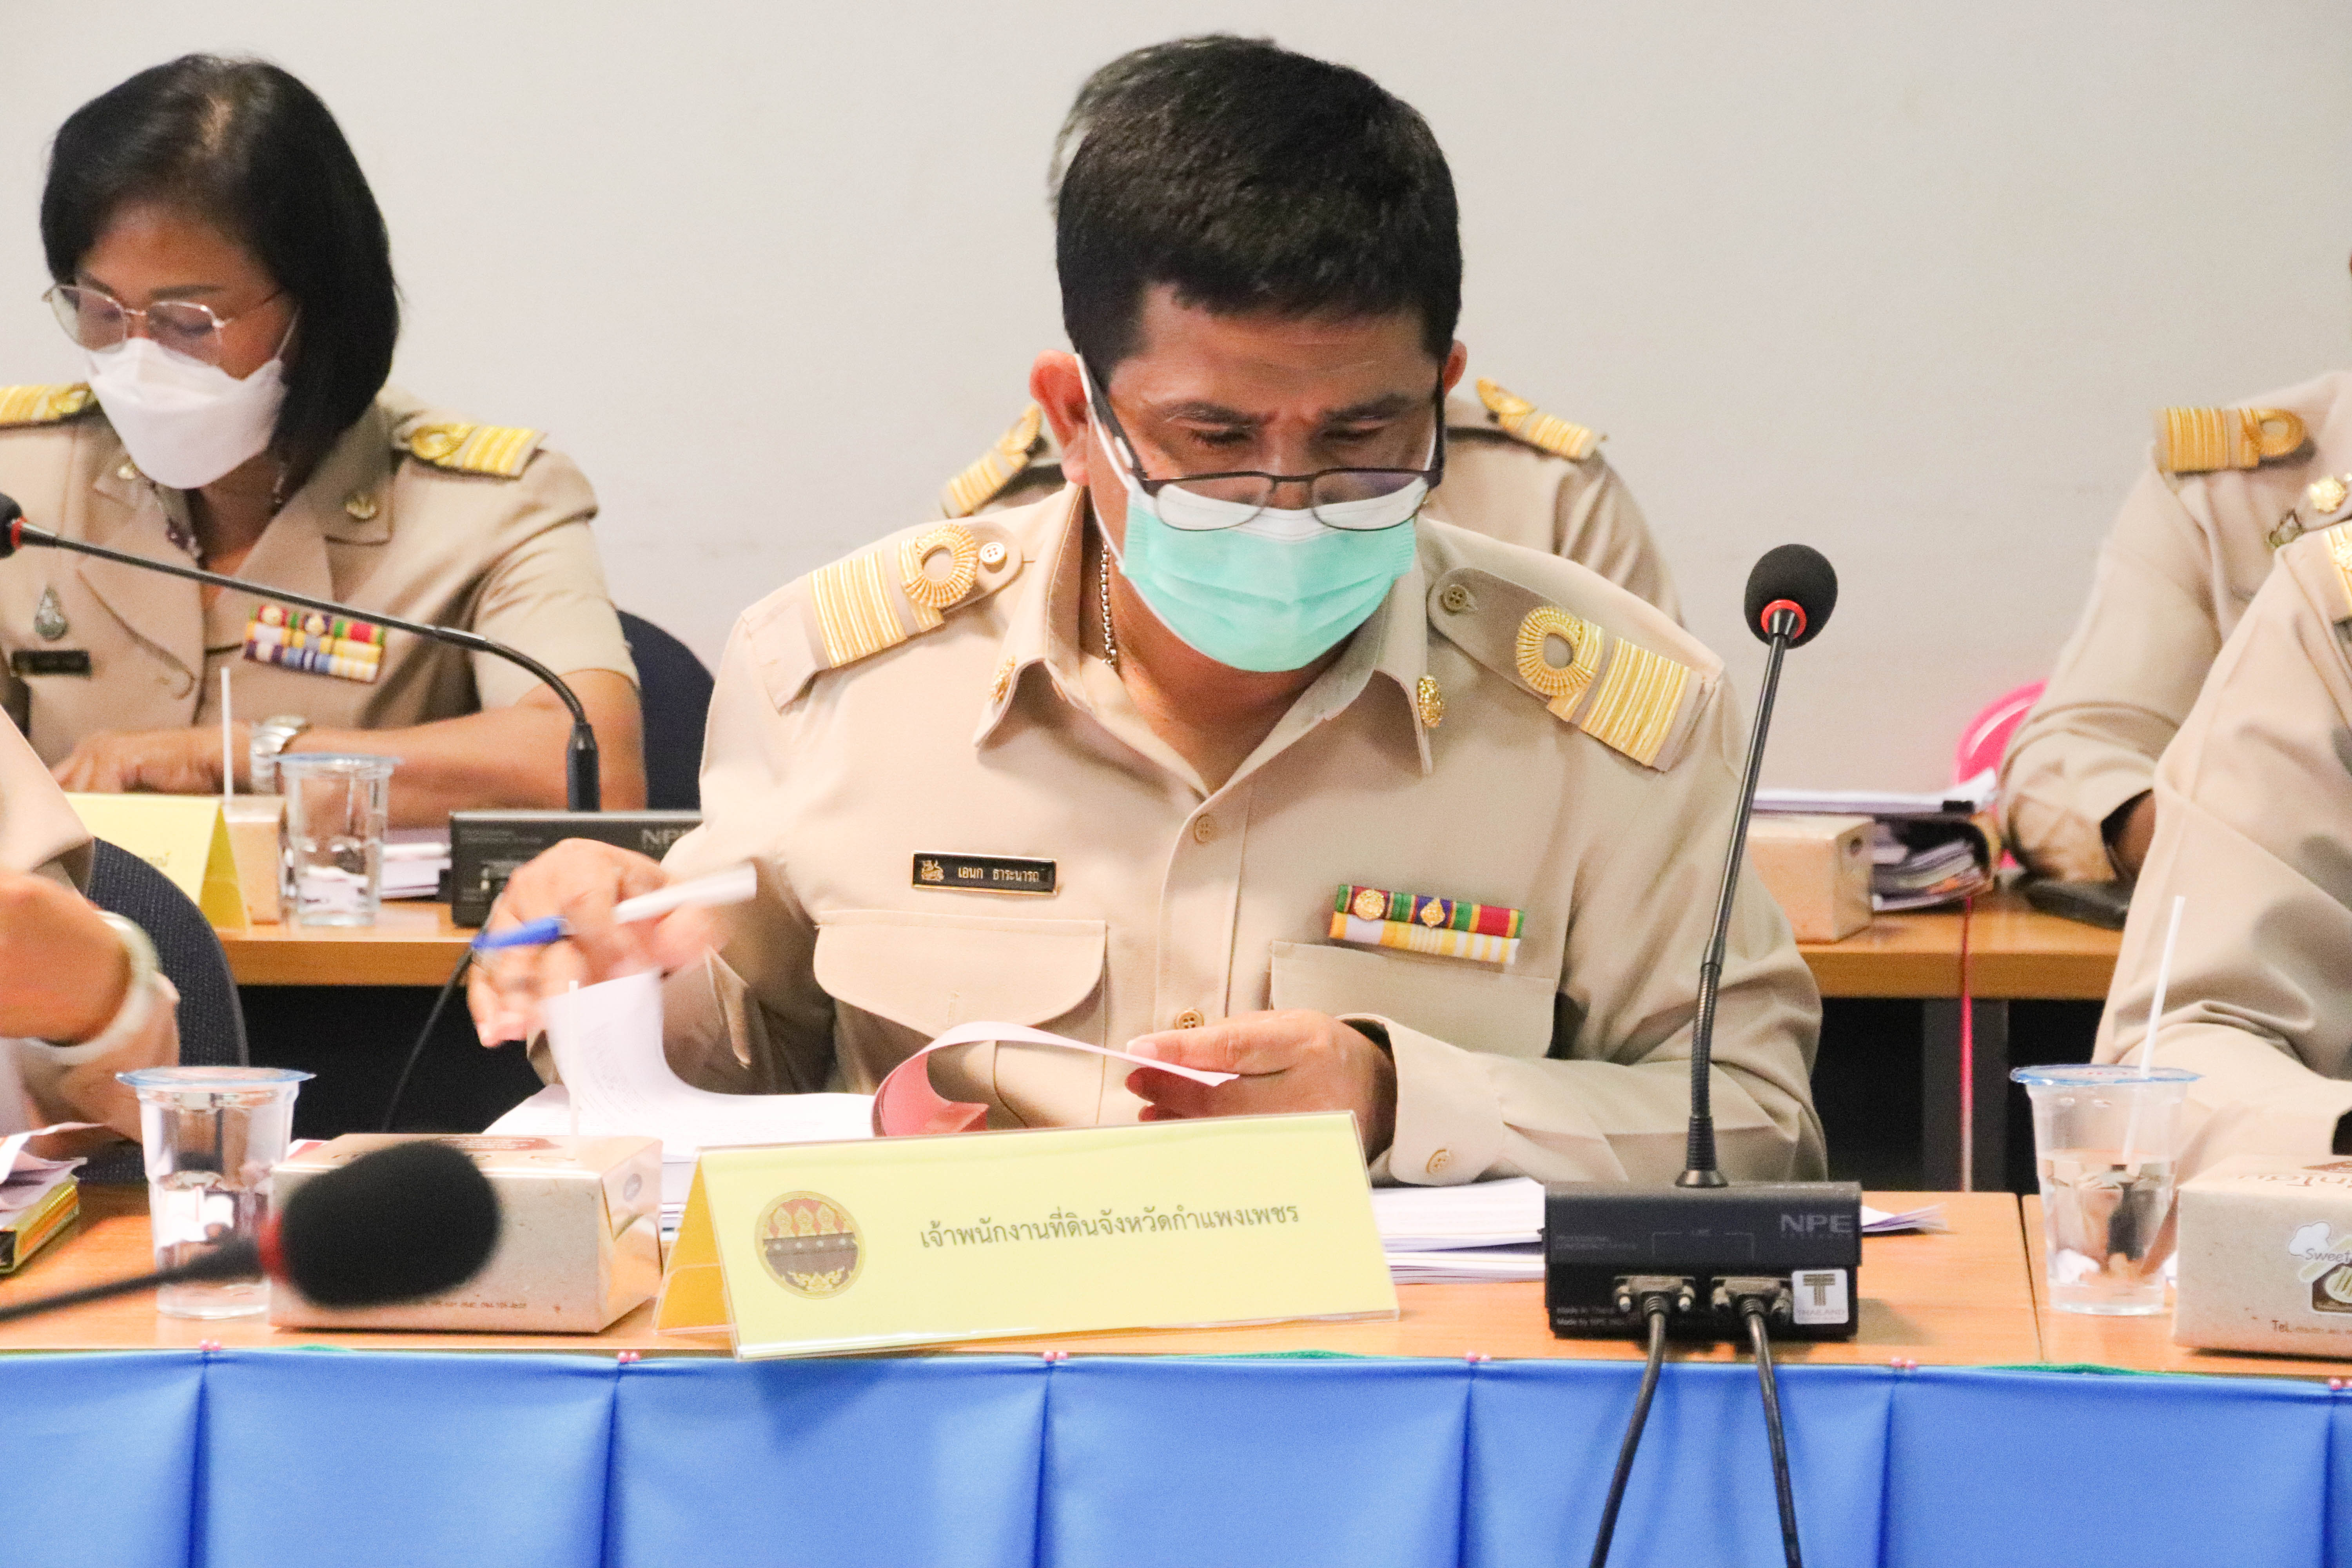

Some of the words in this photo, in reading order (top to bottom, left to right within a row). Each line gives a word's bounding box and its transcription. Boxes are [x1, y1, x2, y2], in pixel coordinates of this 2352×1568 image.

[958, 867, 984, 879] เอนก
[920, 1204, 1299, 1248] เจ้าพนักงานที่ดินจังหวัดกำแพงเพชร
[1781, 1214, 1853, 1233] NPE
[2305, 1248, 2350, 1262] Sweet
